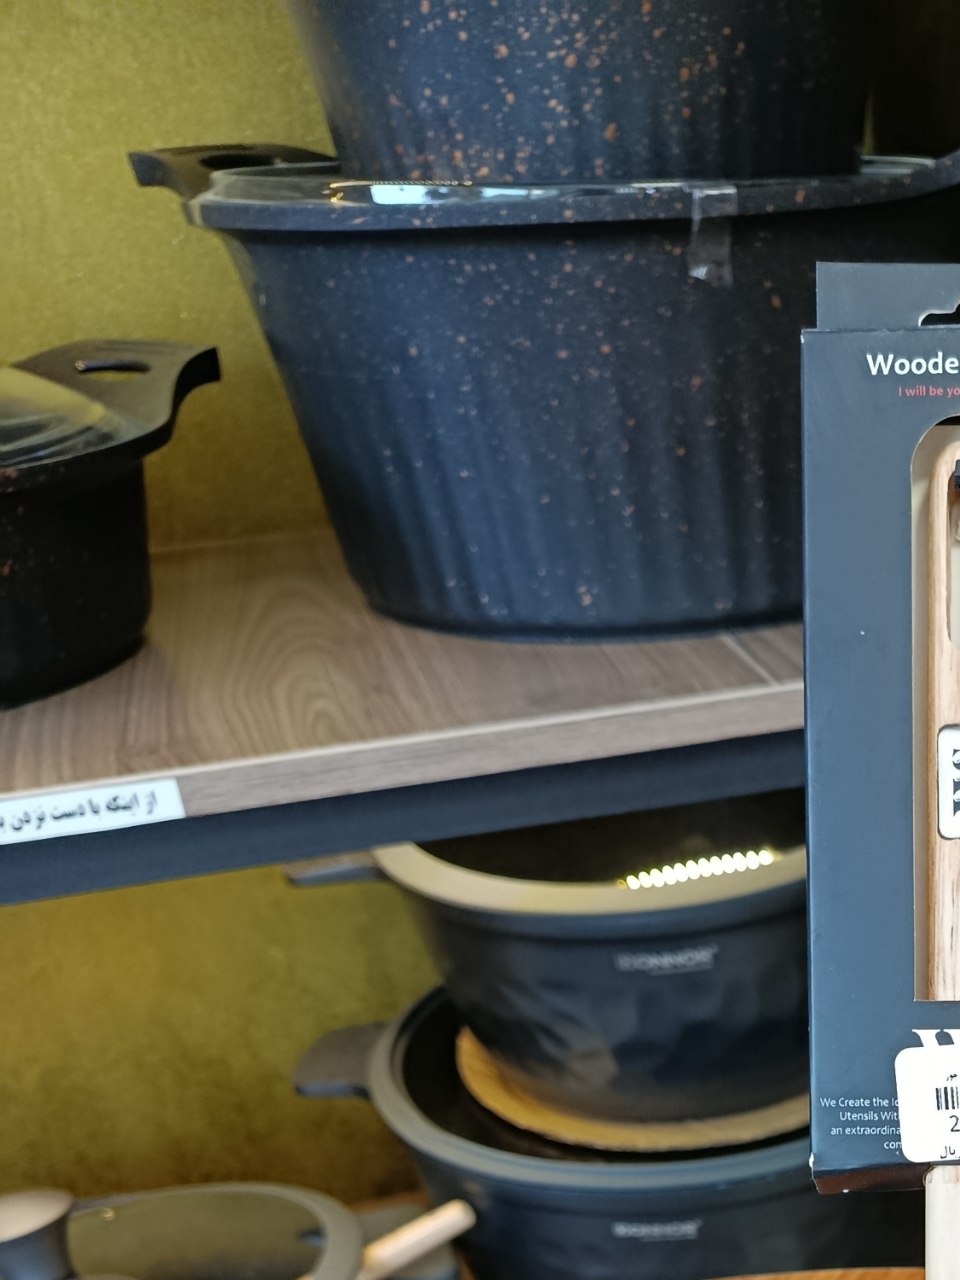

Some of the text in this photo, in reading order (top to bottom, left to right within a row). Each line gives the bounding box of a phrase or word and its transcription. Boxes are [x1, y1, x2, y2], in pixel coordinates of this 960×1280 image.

[898, 386, 902, 397] I
[905, 385, 926, 397] will
[929, 385, 944, 396] be
[820, 1097, 836, 1107] We
[839, 1097, 870, 1107] Create
[873, 1096, 889, 1107] the
[840, 1110, 899, 1121] Utensils Wit
[831, 1125, 901, 1135] an extraordina
